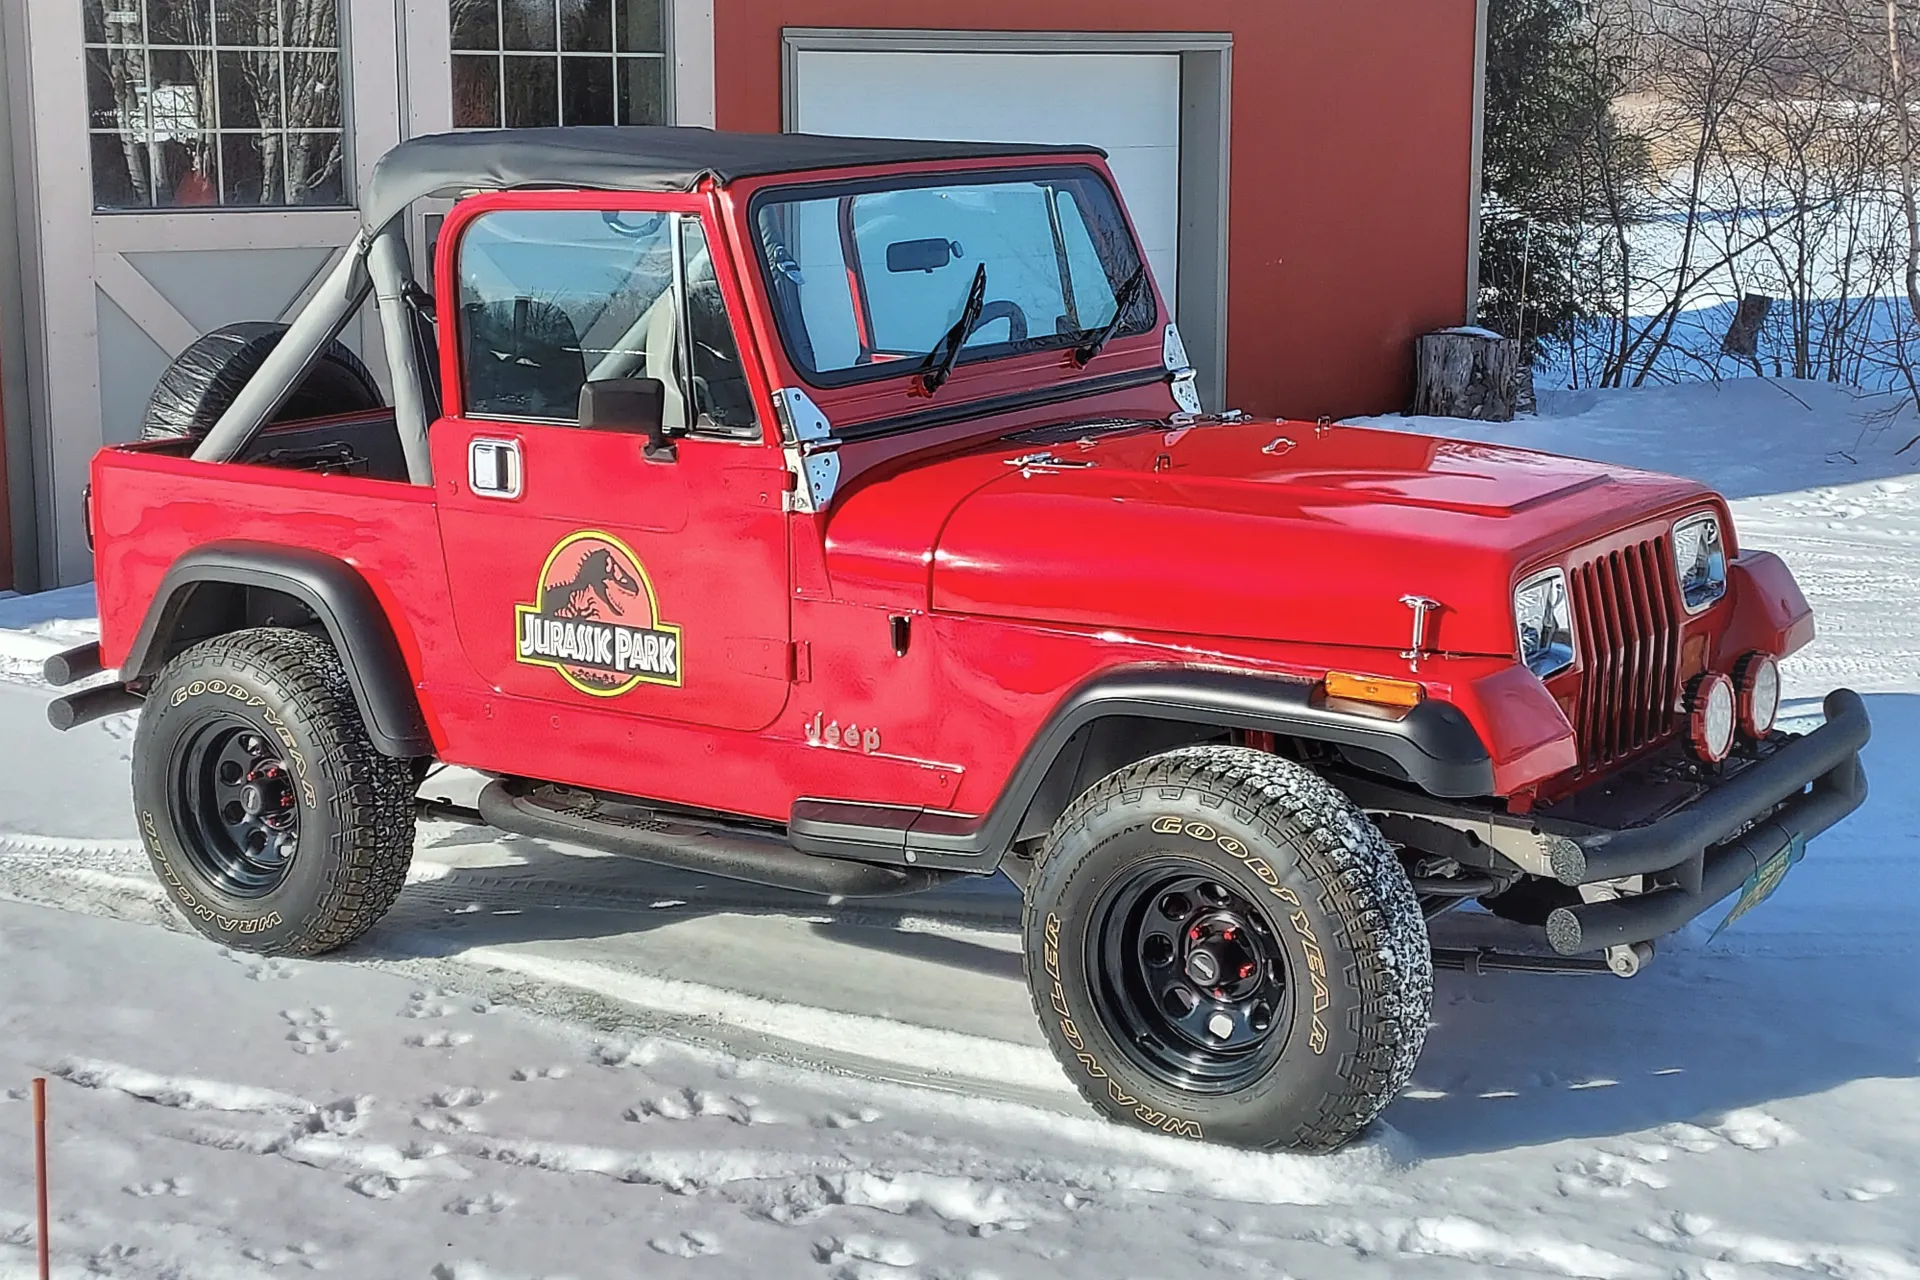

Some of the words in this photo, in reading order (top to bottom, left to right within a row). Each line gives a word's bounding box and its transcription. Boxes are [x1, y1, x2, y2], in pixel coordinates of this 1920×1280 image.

[520, 613, 613, 665] JURASSIC
[614, 626, 676, 675] PARK
[170, 679, 316, 809] GOODYEAR
[142, 810, 282, 933] WRANGLER
[1123, 823, 1145, 835] AT
[1151, 815, 1330, 1056] GOODYEAR
[1044, 912, 1204, 1139] WRANGLER
